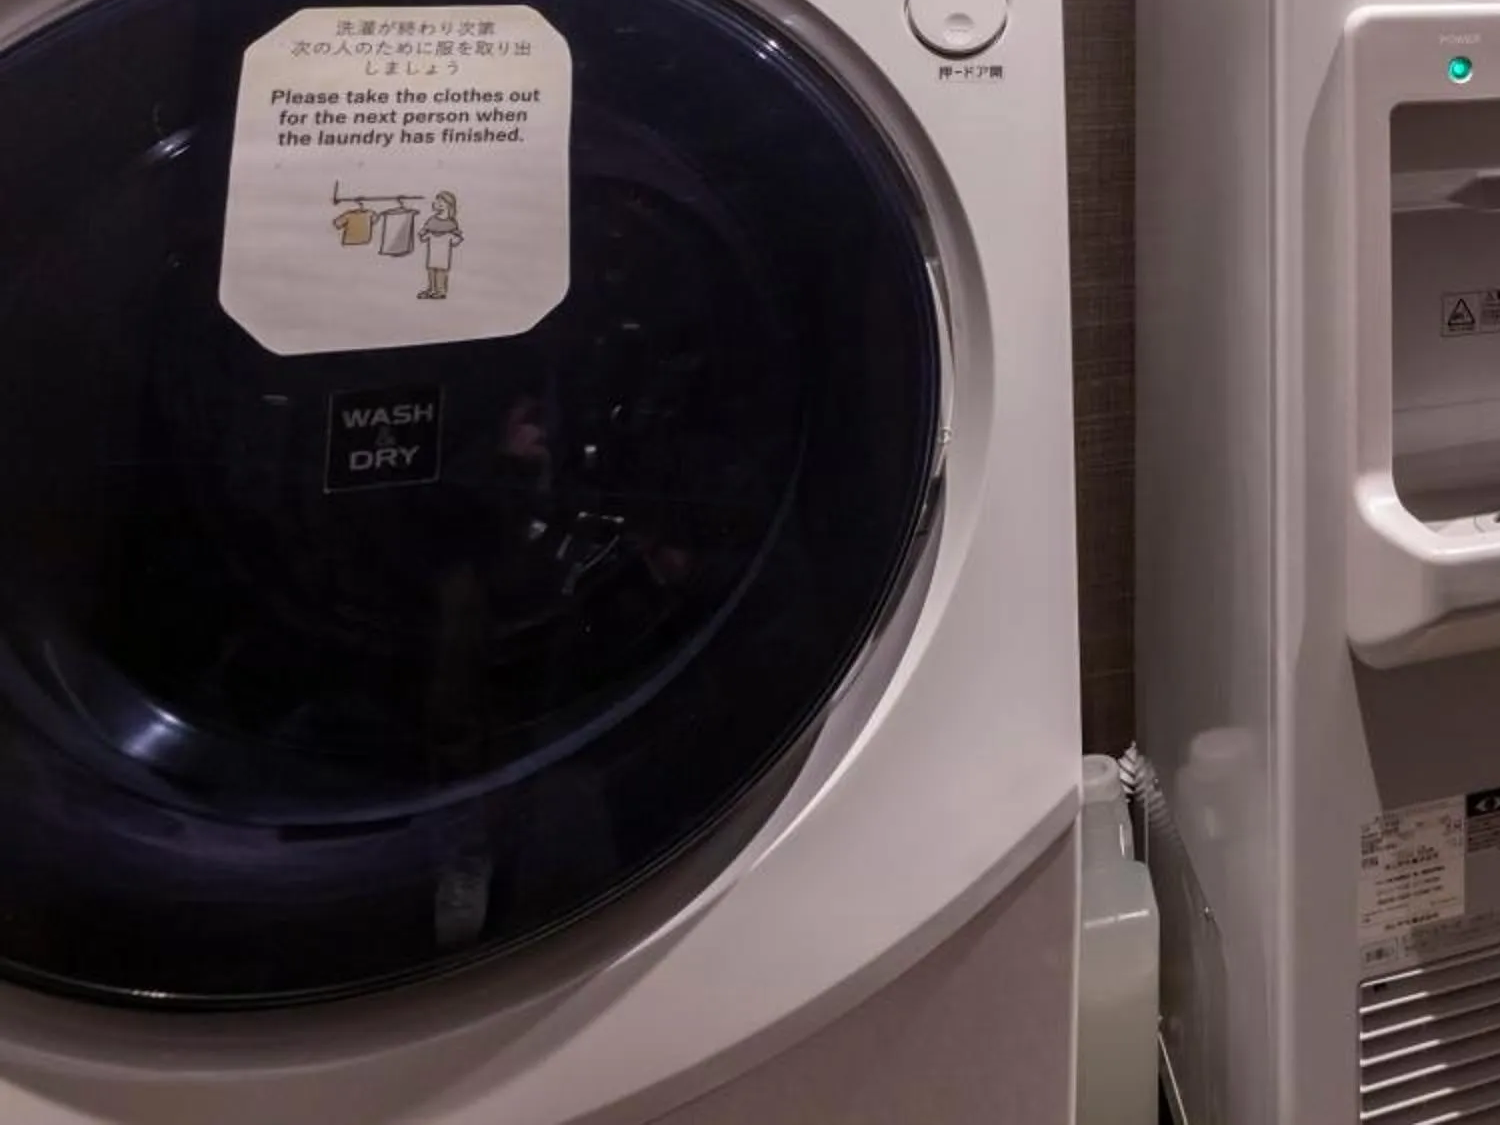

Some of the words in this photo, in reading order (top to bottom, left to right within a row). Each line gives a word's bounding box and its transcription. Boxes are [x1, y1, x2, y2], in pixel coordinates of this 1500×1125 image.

[336, 19, 497, 36] 洗濯が終わり次第
[290, 41, 533, 57] 次の人のために服を取り出
[364, 61, 460, 76] しましょう
[270, 89, 339, 105] Please
[346, 89, 389, 104] take
[396, 89, 429, 104] the
[433, 88, 504, 104] clothes
[509, 89, 541, 103] out
[279, 110, 307, 125] for
[315, 110, 348, 125] the
[353, 110, 398, 125] next
[402, 111, 470, 128] person
[475, 108, 529, 123] when
[278, 130, 312, 147] the
[317, 130, 395, 148] laundry
[400, 129, 435, 144] has
[441, 128, 525, 143] finished.
[341, 403, 434, 429] WASH
[349, 444, 421, 471] DRY
